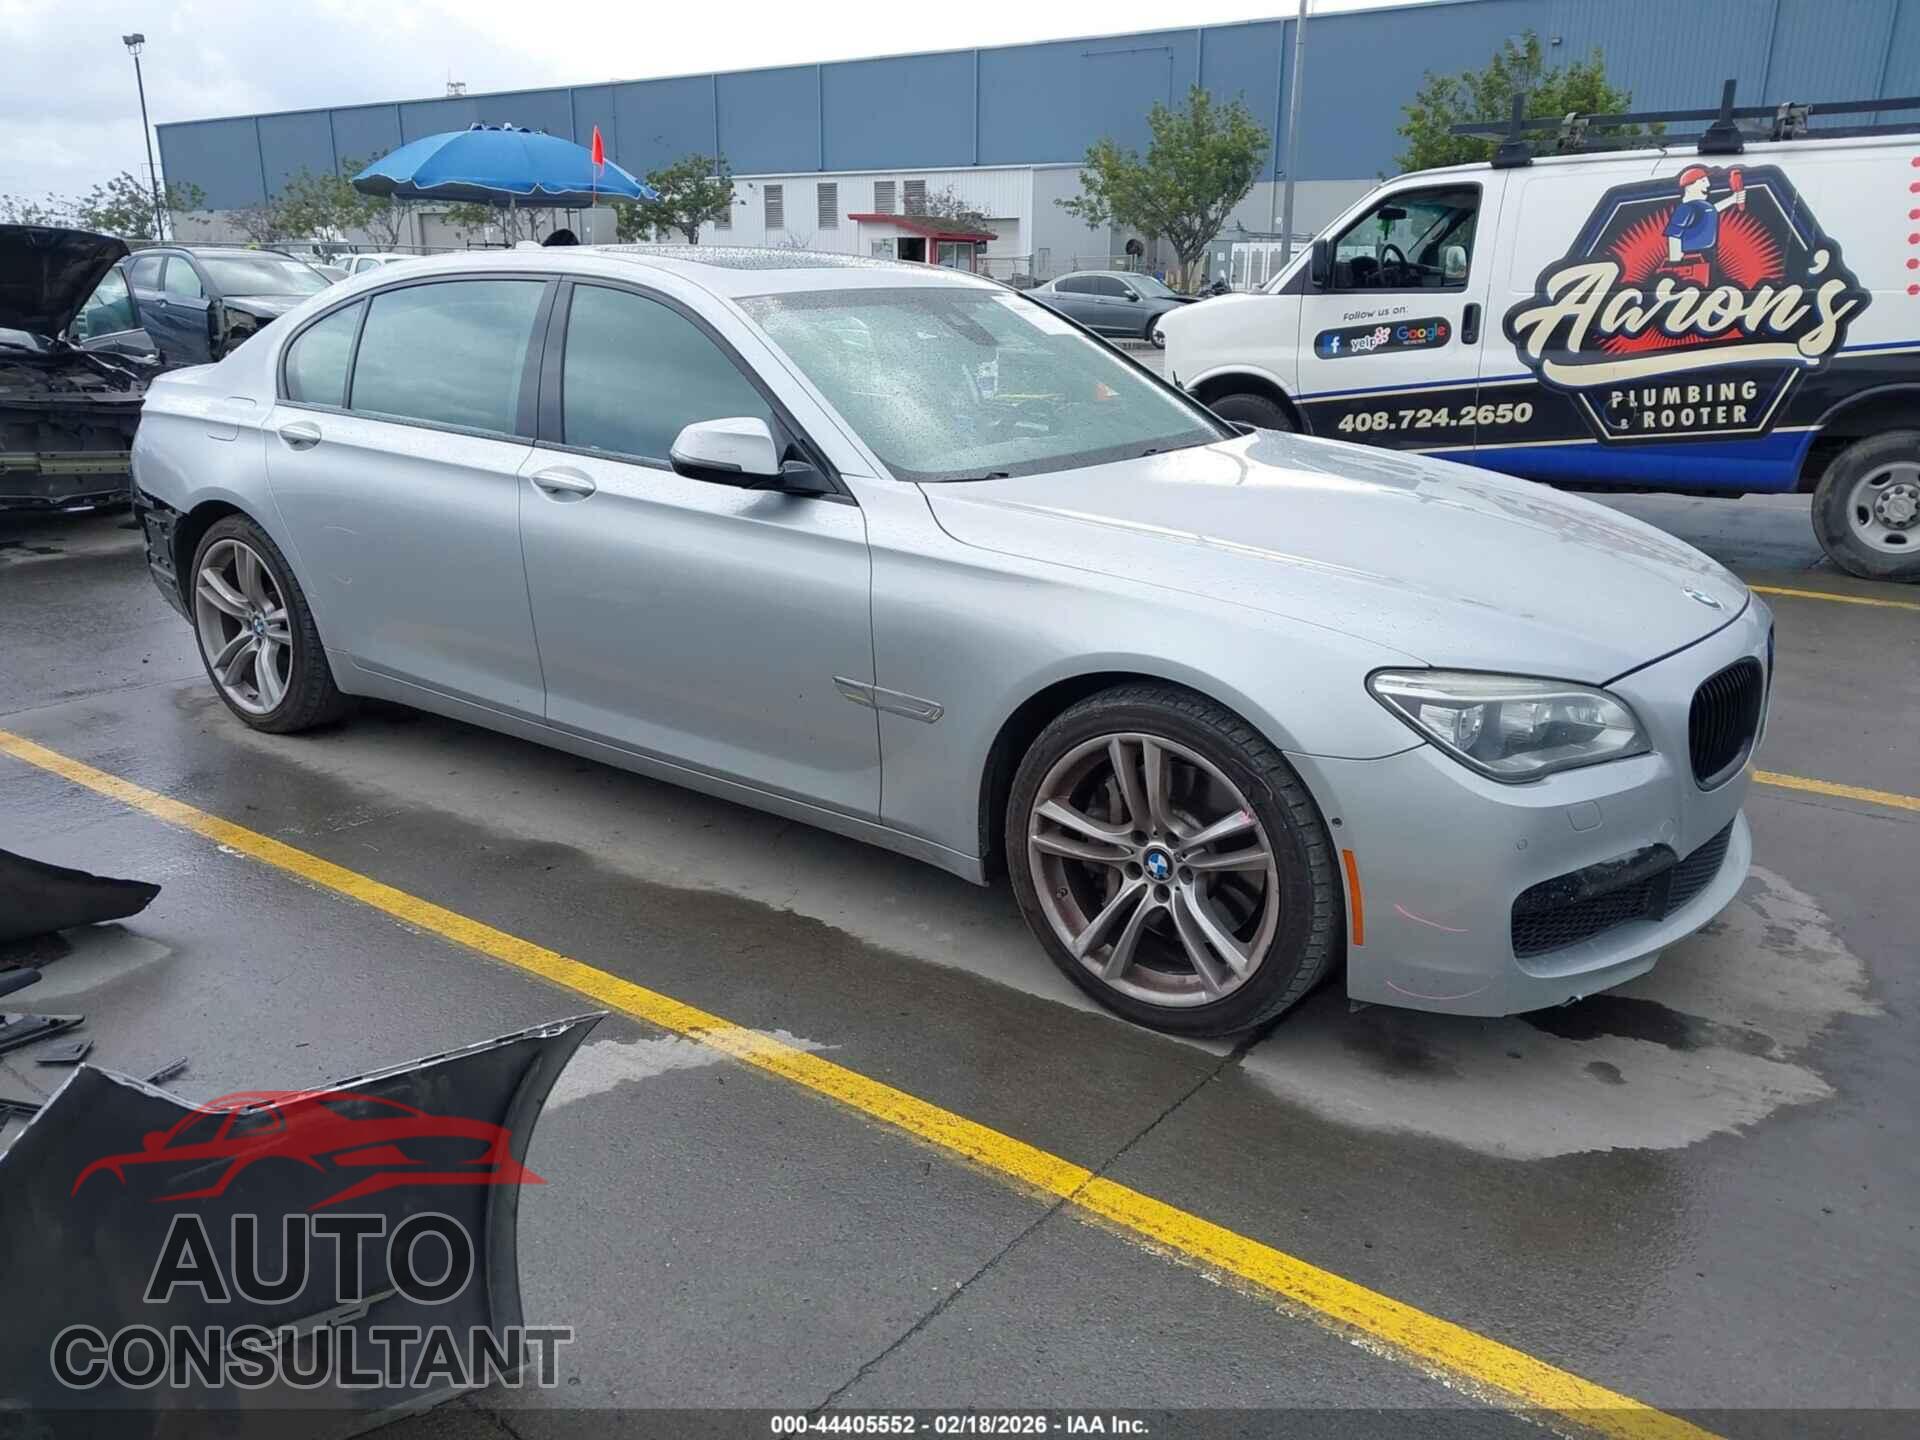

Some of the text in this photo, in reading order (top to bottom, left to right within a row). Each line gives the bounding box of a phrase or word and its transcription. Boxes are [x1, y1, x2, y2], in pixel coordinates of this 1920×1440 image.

[1343, 309, 1374, 321] Follow
[1378, 308, 1389, 317] us
[1514, 249, 1857, 358] Aaron's
[1351, 334, 1377, 352] yelp
[1397, 323, 1446, 341] Google
[1611, 381, 1757, 408] PLUMBING
[1338, 403, 1533, 432] 408.724.2650
[1643, 405, 1747, 428] ROOTER
